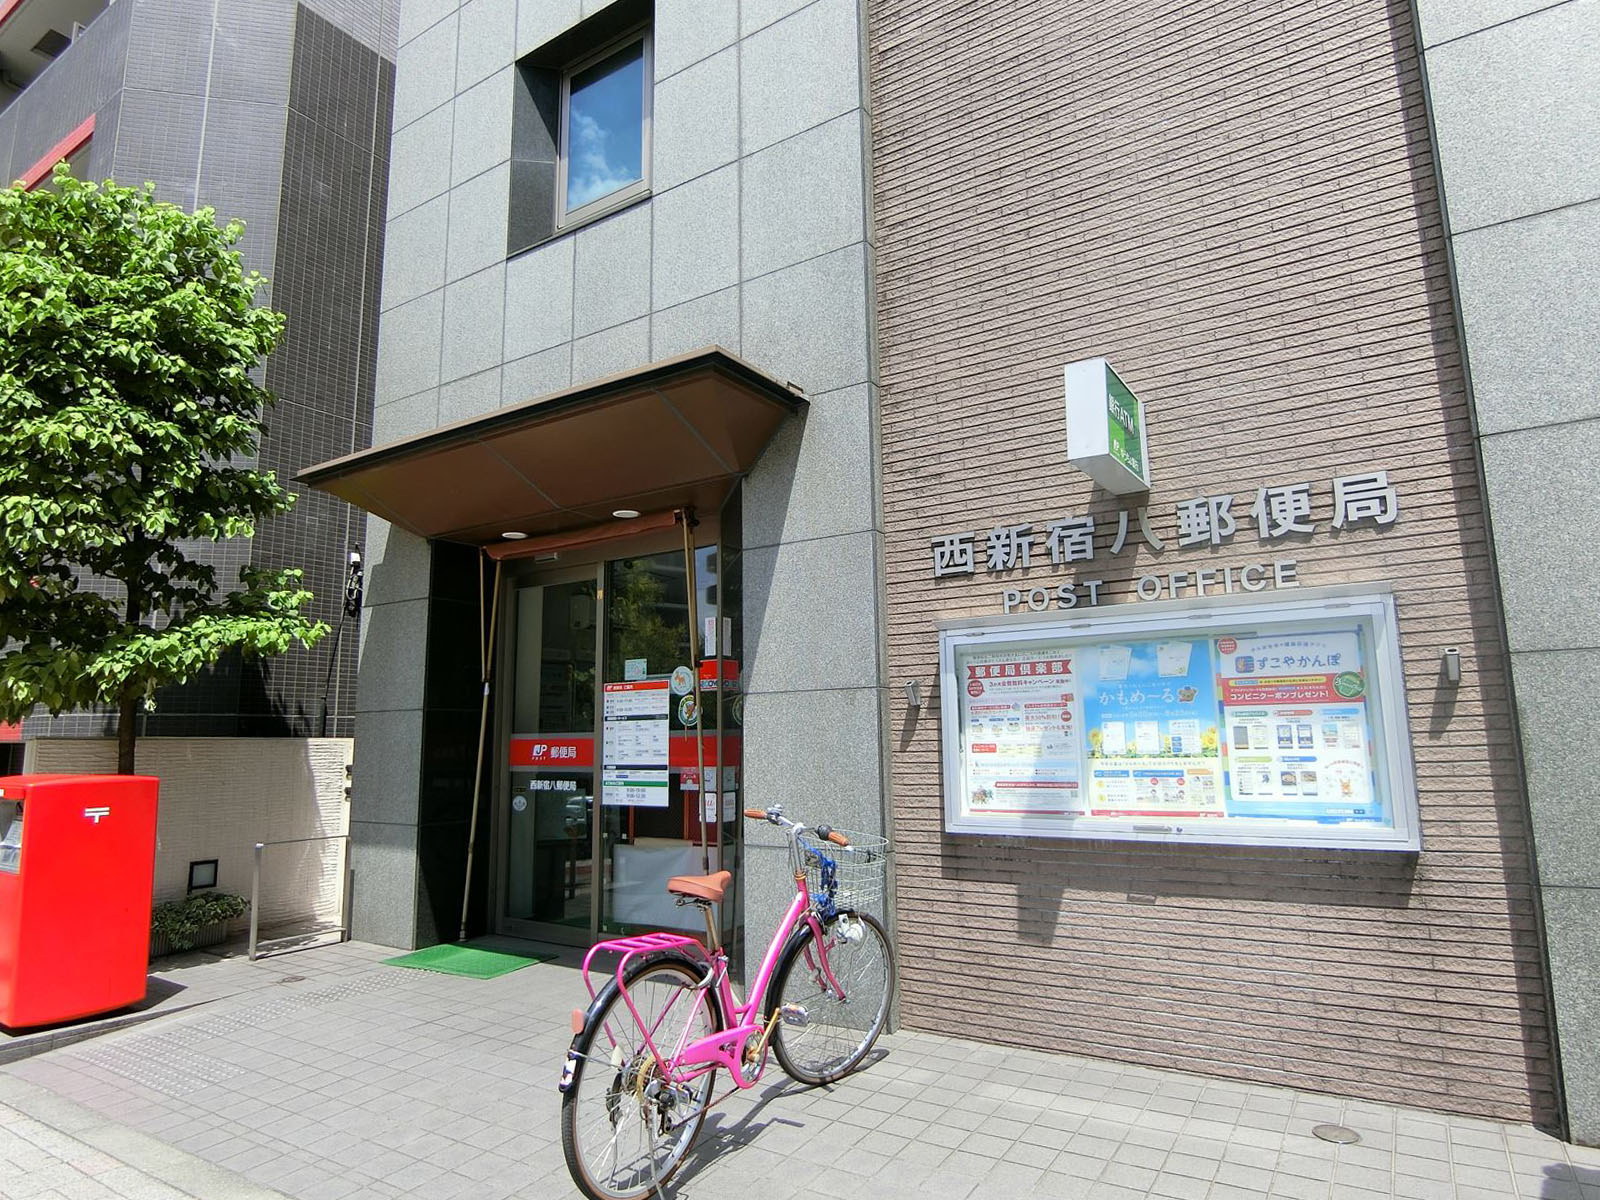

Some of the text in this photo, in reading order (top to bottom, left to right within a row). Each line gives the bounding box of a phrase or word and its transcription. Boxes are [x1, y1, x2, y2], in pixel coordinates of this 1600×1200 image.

[1109, 393, 1135, 435] 銀行ATM
[931, 470, 1398, 578] 西新宿八郵便局
[1002, 559, 1301, 614] POST OFFICE
[550, 746, 577, 759] 郵便局
[530, 780, 577, 791] 西新宿八郵便局
